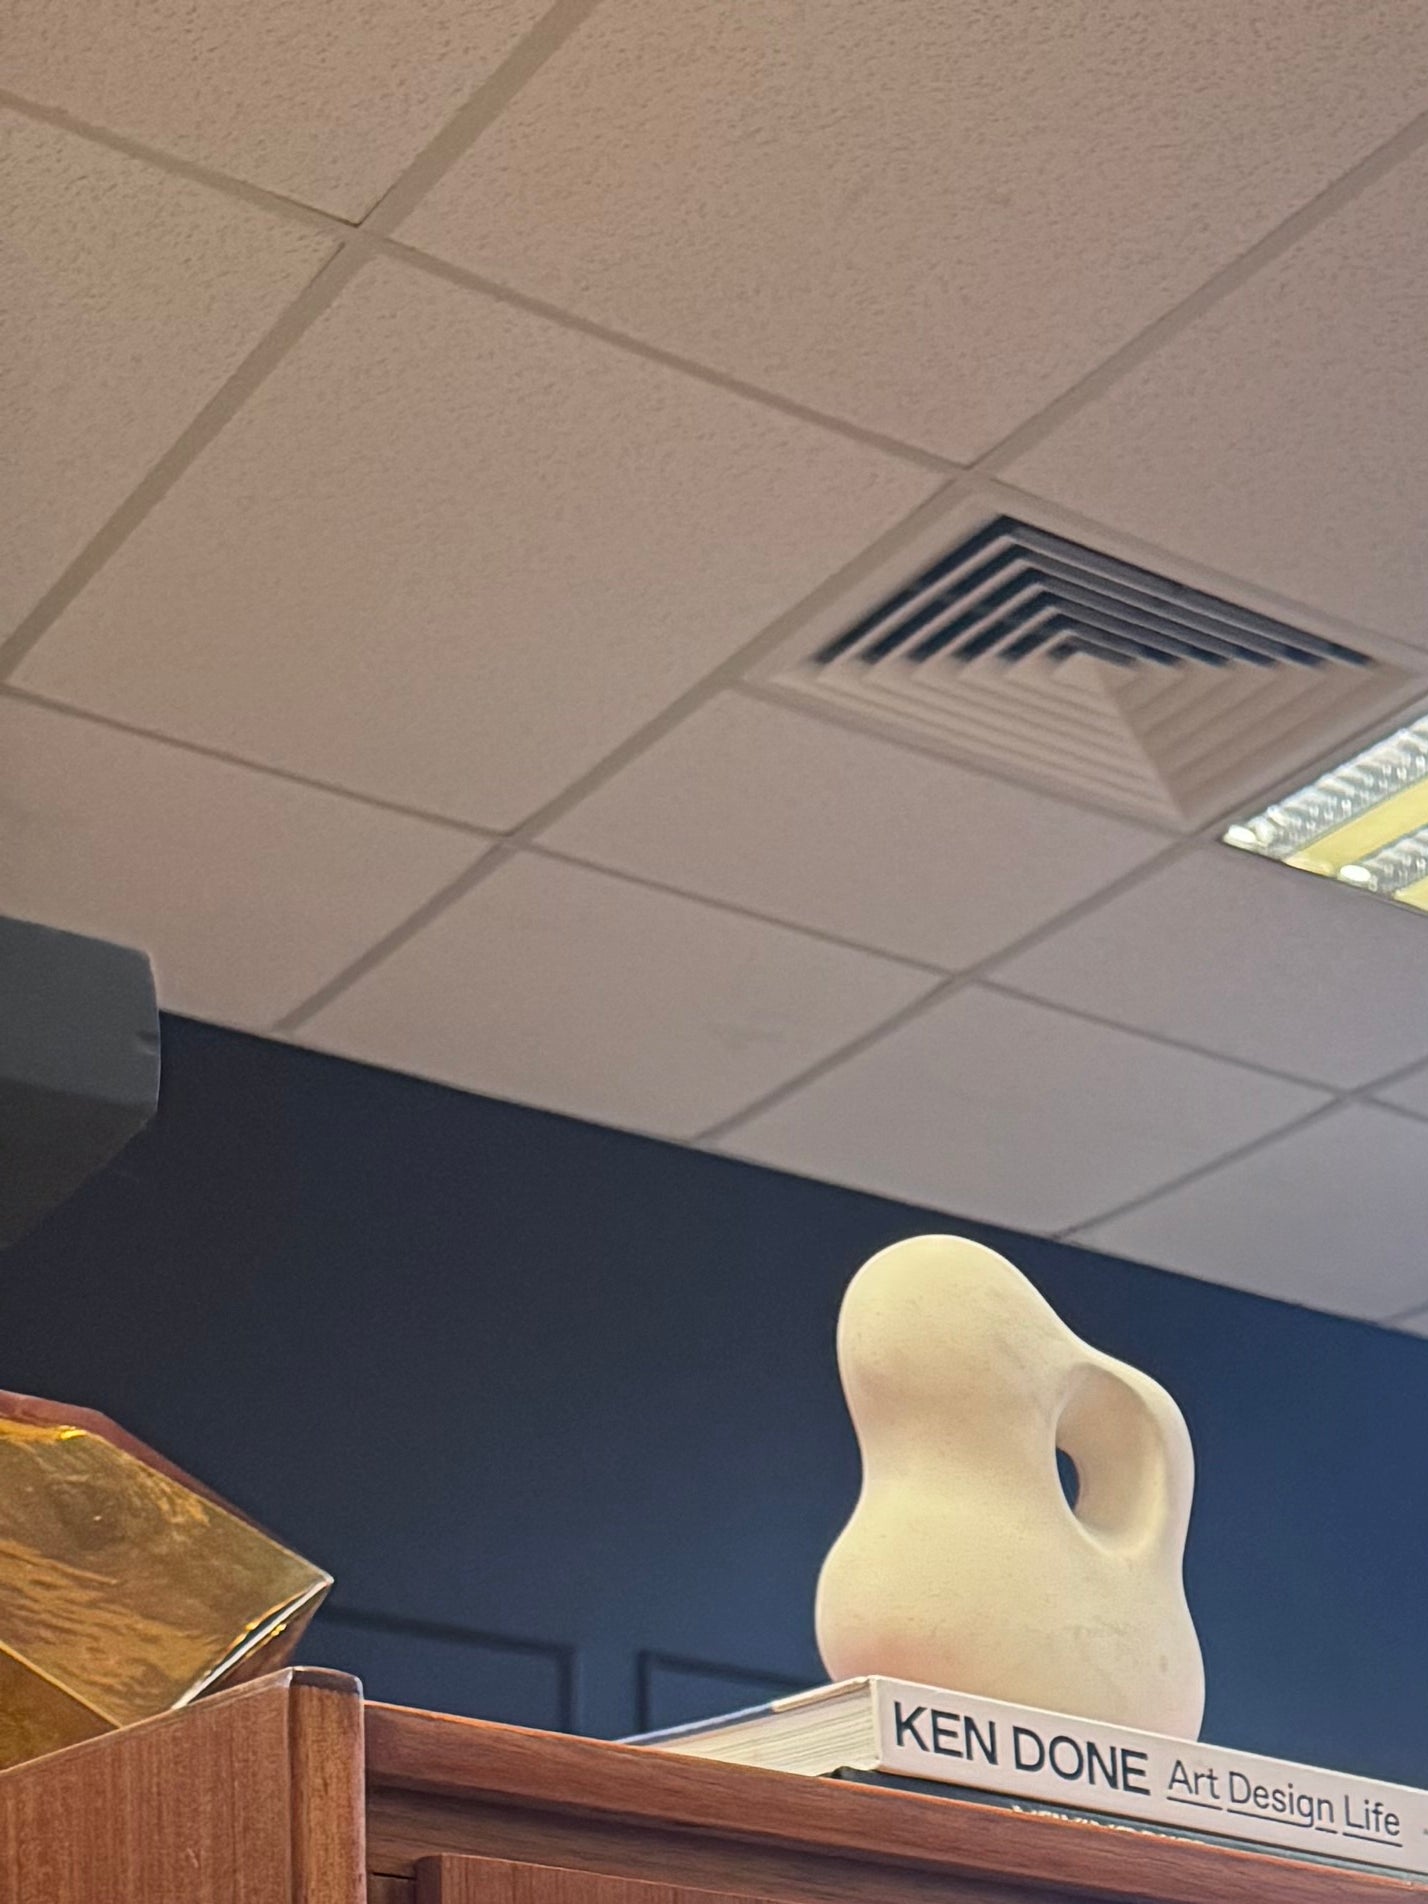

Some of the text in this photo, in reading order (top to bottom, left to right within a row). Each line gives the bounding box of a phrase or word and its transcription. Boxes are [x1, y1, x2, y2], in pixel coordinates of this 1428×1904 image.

[894, 1701, 998, 1766] KEN
[1012, 1725, 1151, 1796] DONE
[1168, 1760, 1220, 1800] Art
[1229, 1771, 1335, 1828] Design
[1344, 1795, 1401, 1837] Life
